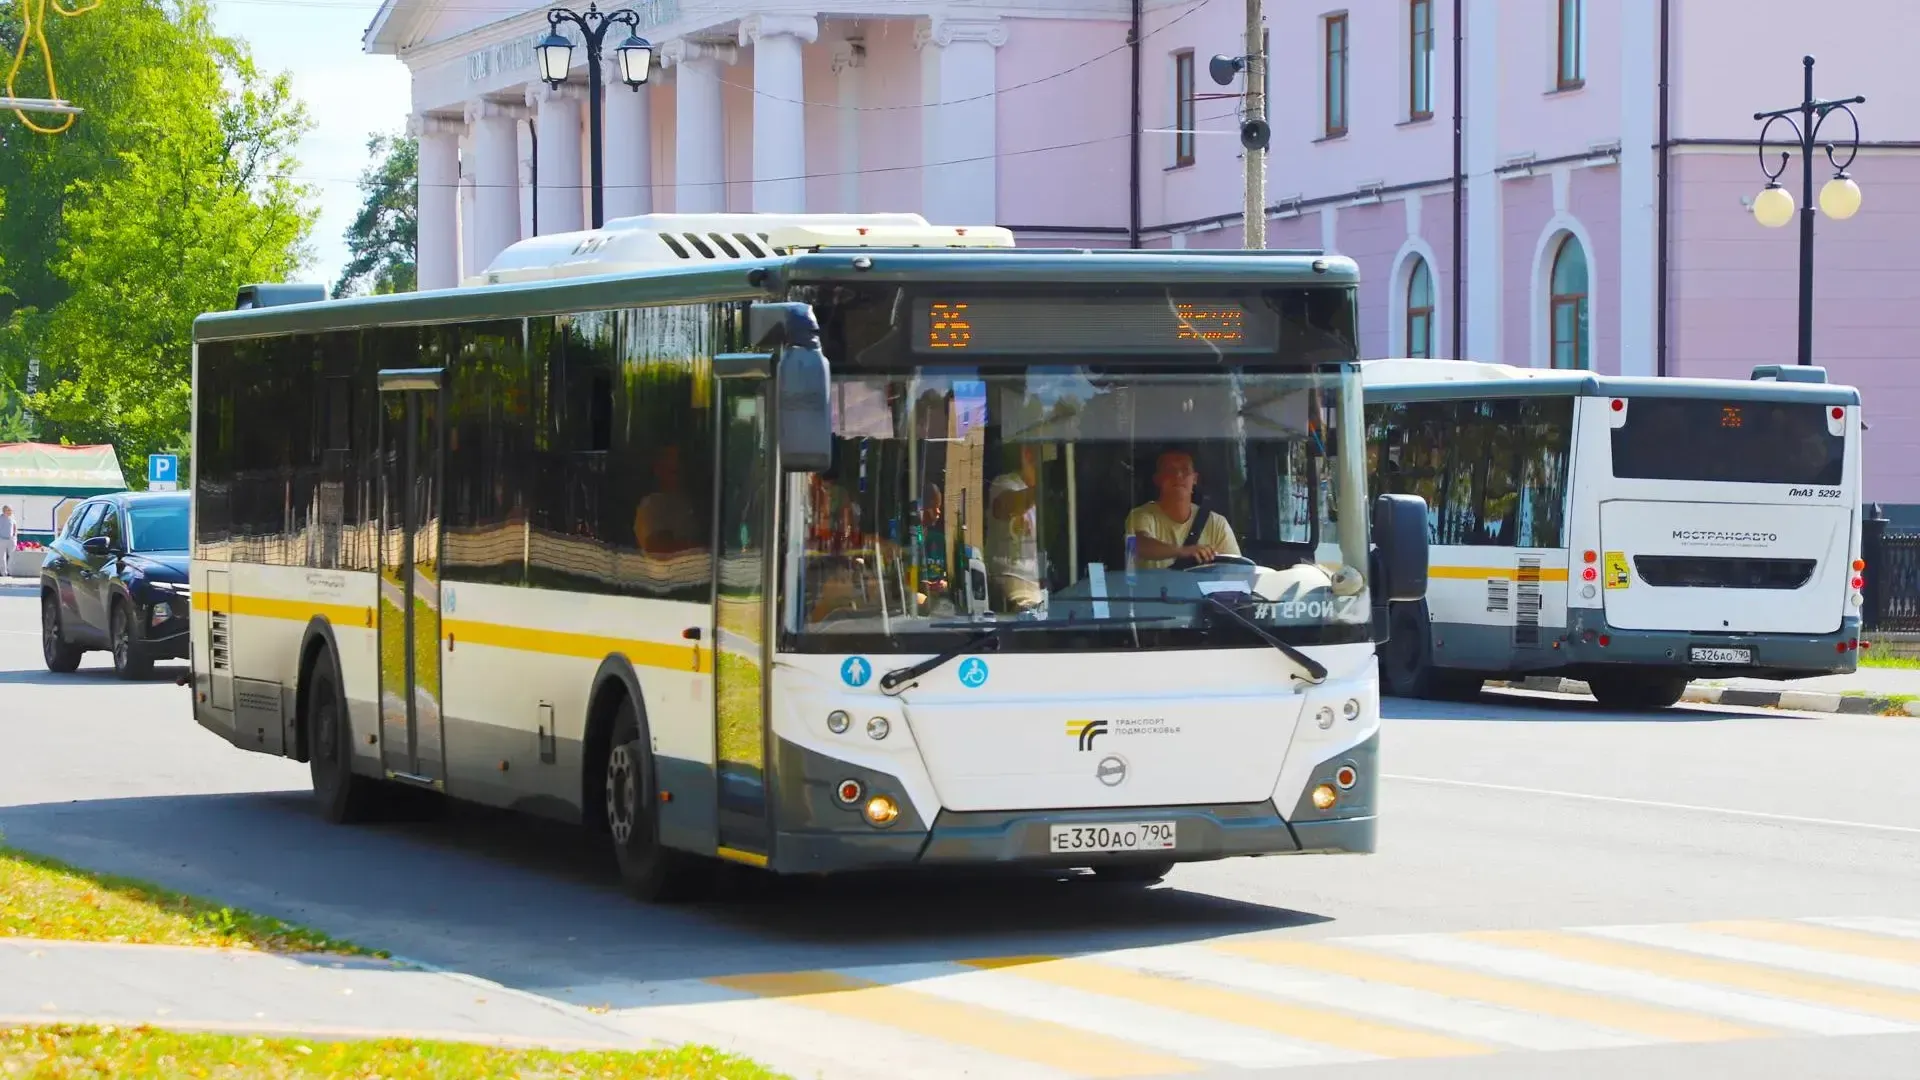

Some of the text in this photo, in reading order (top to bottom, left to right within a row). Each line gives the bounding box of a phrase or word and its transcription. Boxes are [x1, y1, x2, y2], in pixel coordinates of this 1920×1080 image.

[156, 458, 170, 479] P
[1817, 489, 1842, 498] 5292
[1672, 530, 1777, 542] МОСТРАНСАВТО
[1114, 727, 1181, 735] ПОДМОСКОВЬЯ
[1058, 827, 1137, 849] Е330АО
